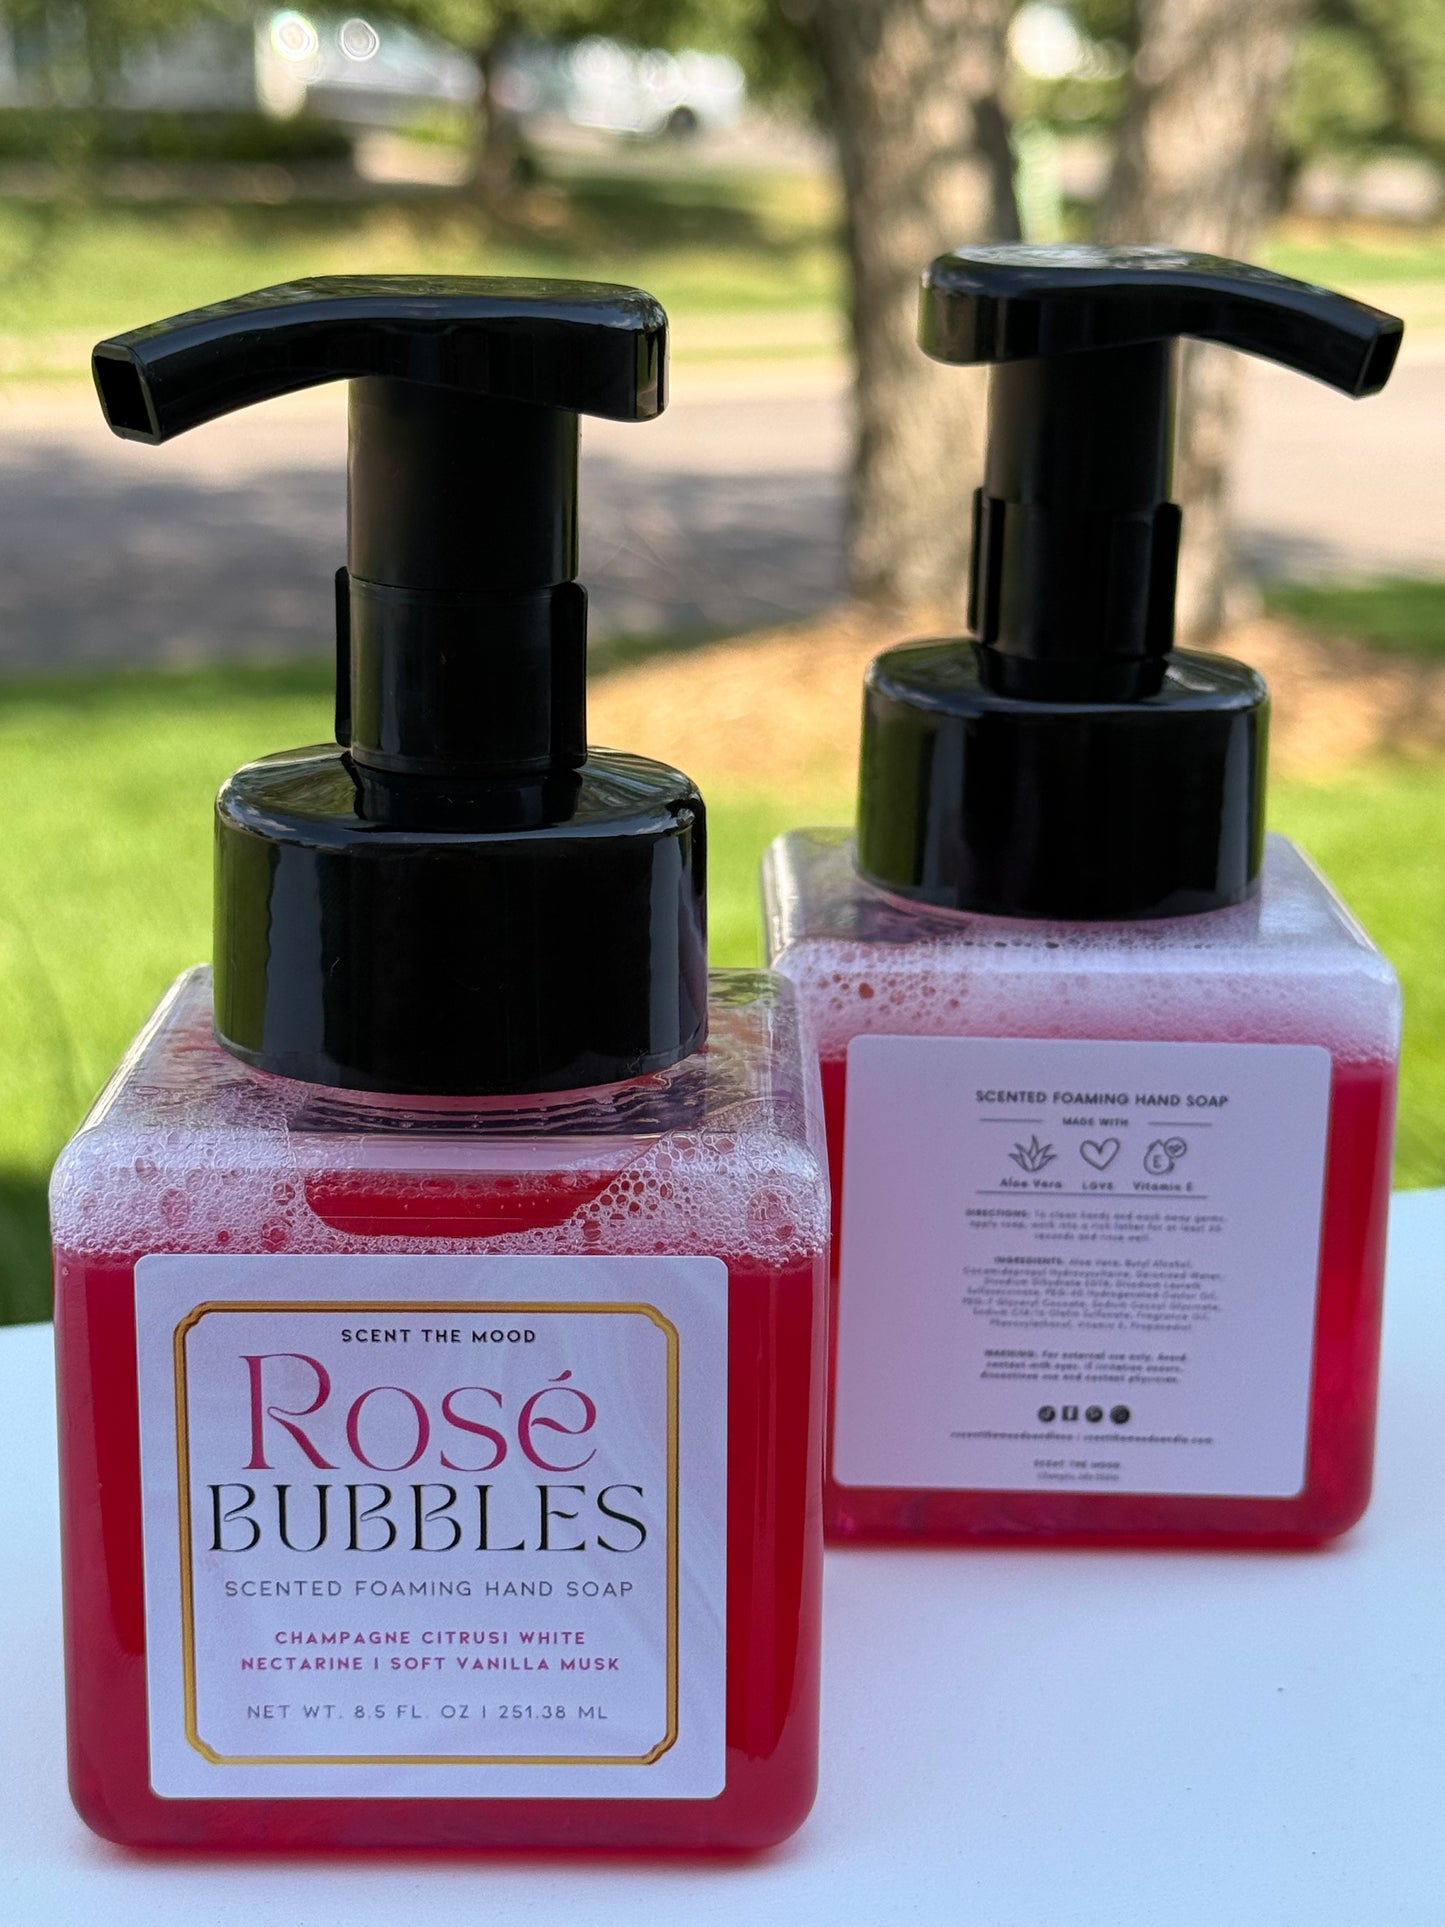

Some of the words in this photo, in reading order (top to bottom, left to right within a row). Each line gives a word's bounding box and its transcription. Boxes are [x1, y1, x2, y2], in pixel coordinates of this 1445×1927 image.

[976, 1090, 1047, 1103] SCENTED
[1053, 1091, 1129, 1105] FOAMING
[1135, 1094, 1181, 1106] HAND
[1186, 1095, 1229, 1108] SOAP
[1062, 1117, 1094, 1126] MADE
[1099, 1118, 1128, 1127] WITH
[1000, 1177, 1028, 1188] Aloe
[1033, 1179, 1063, 1189] Vera
[1132, 1181, 1182, 1191] Vitamin
[1186, 1181, 1194, 1191] E
[341, 1329, 411, 1344] SCENT
[421, 1329, 461, 1344] THE
[472, 1329, 537, 1344] MOOD
[207, 1483, 648, 1553] BUBBLES
[225, 1581, 342, 1597] SCENTED
[355, 1581, 472, 1597] FOAMING
[486, 1581, 553, 1597] HAND
[567, 1581, 633, 1597] SOAP
[275, 1631, 411, 1645] CHAMPAGNE
[519, 1631, 585, 1645] WHITE
[241, 1657, 363, 1671] NECTARINE
[391, 1657, 446, 1671] SOFT
[457, 1657, 549, 1671] VANILLA
[560, 1658, 620, 1672] MUSK
[248, 1705, 290, 1719] NET
[303, 1705, 343, 1719] WT.
[354, 1705, 386, 1719] 8.5
[397, 1705, 430, 1719] FL.
[441, 1705, 469, 1719] OZ
[499, 1705, 566, 1719] 251.38
[579, 1706, 608, 1719] ML
